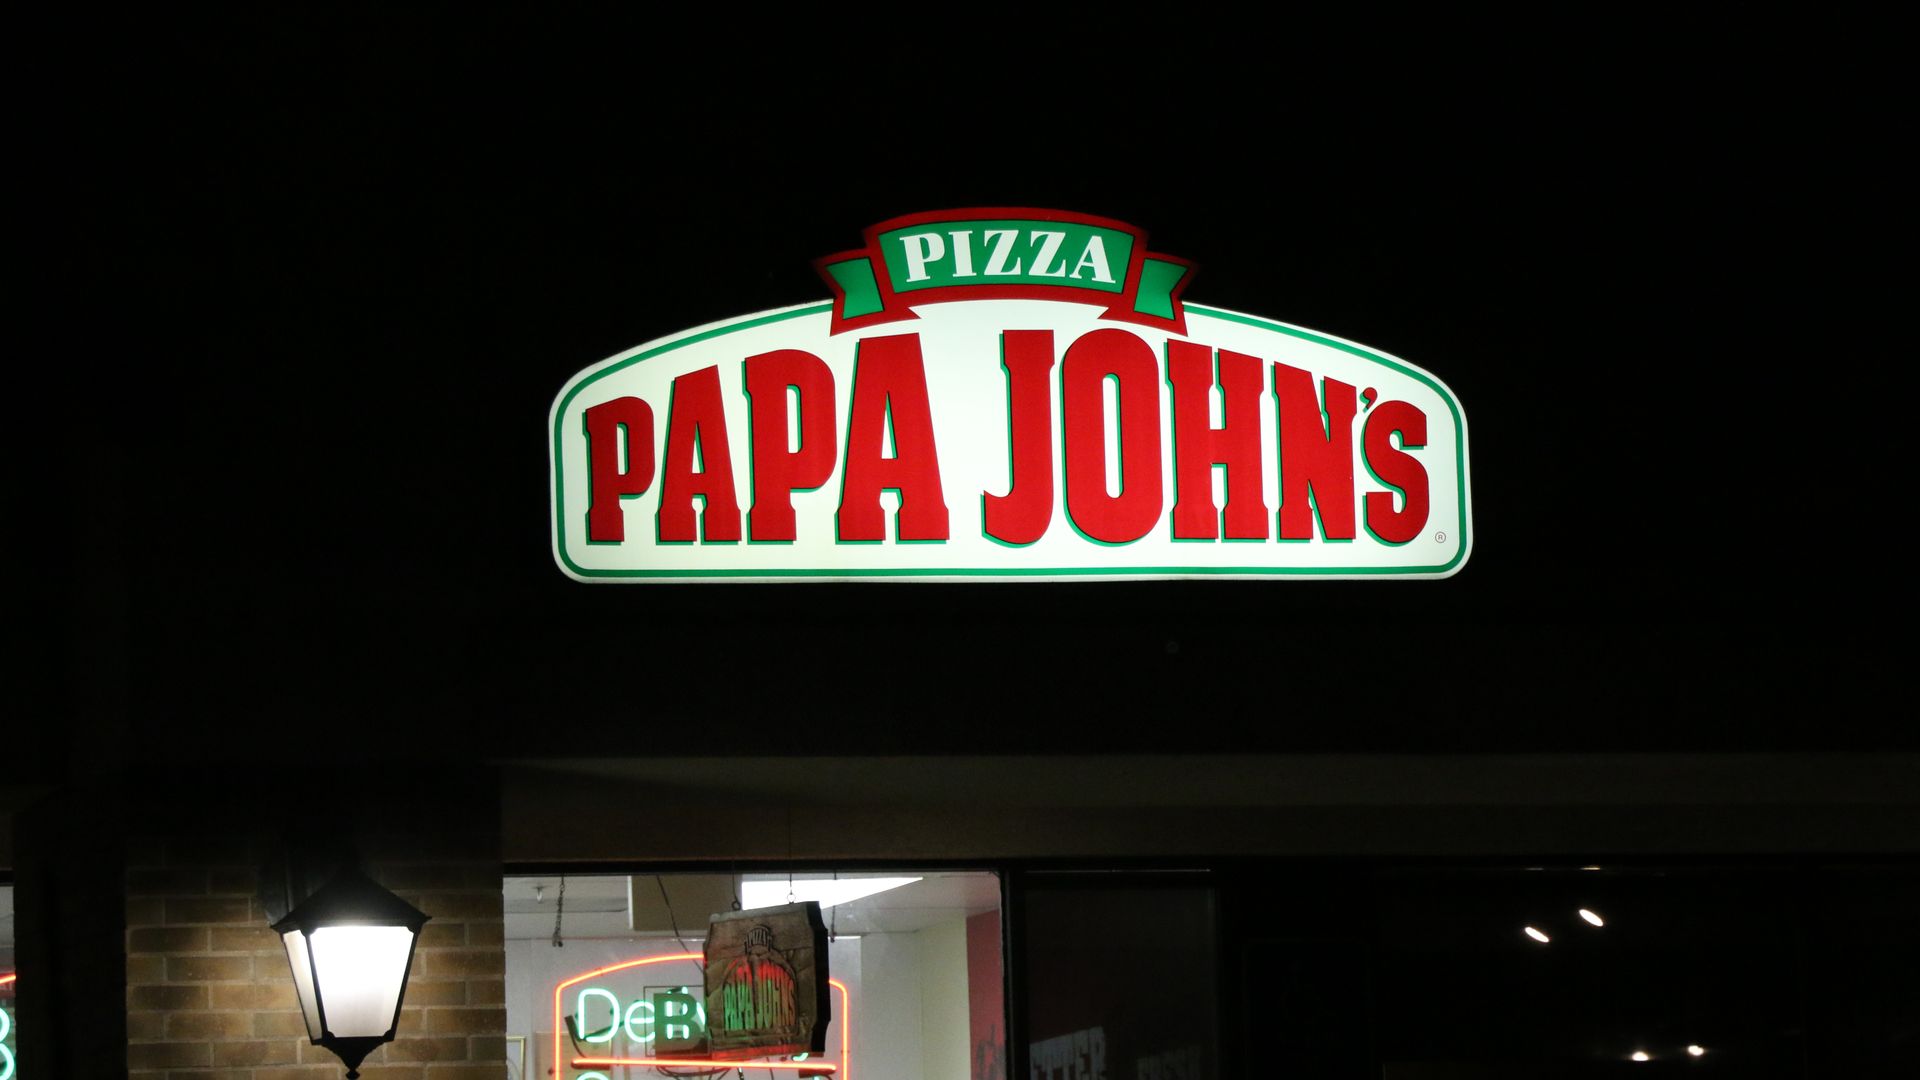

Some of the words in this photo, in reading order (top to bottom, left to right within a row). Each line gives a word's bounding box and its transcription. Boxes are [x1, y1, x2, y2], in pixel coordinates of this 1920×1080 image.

[899, 229, 1116, 284] PIZZA
[582, 332, 950, 546] PAPA
[980, 328, 1430, 548] JOHN'S
[723, 961, 755, 1032] PAPA
